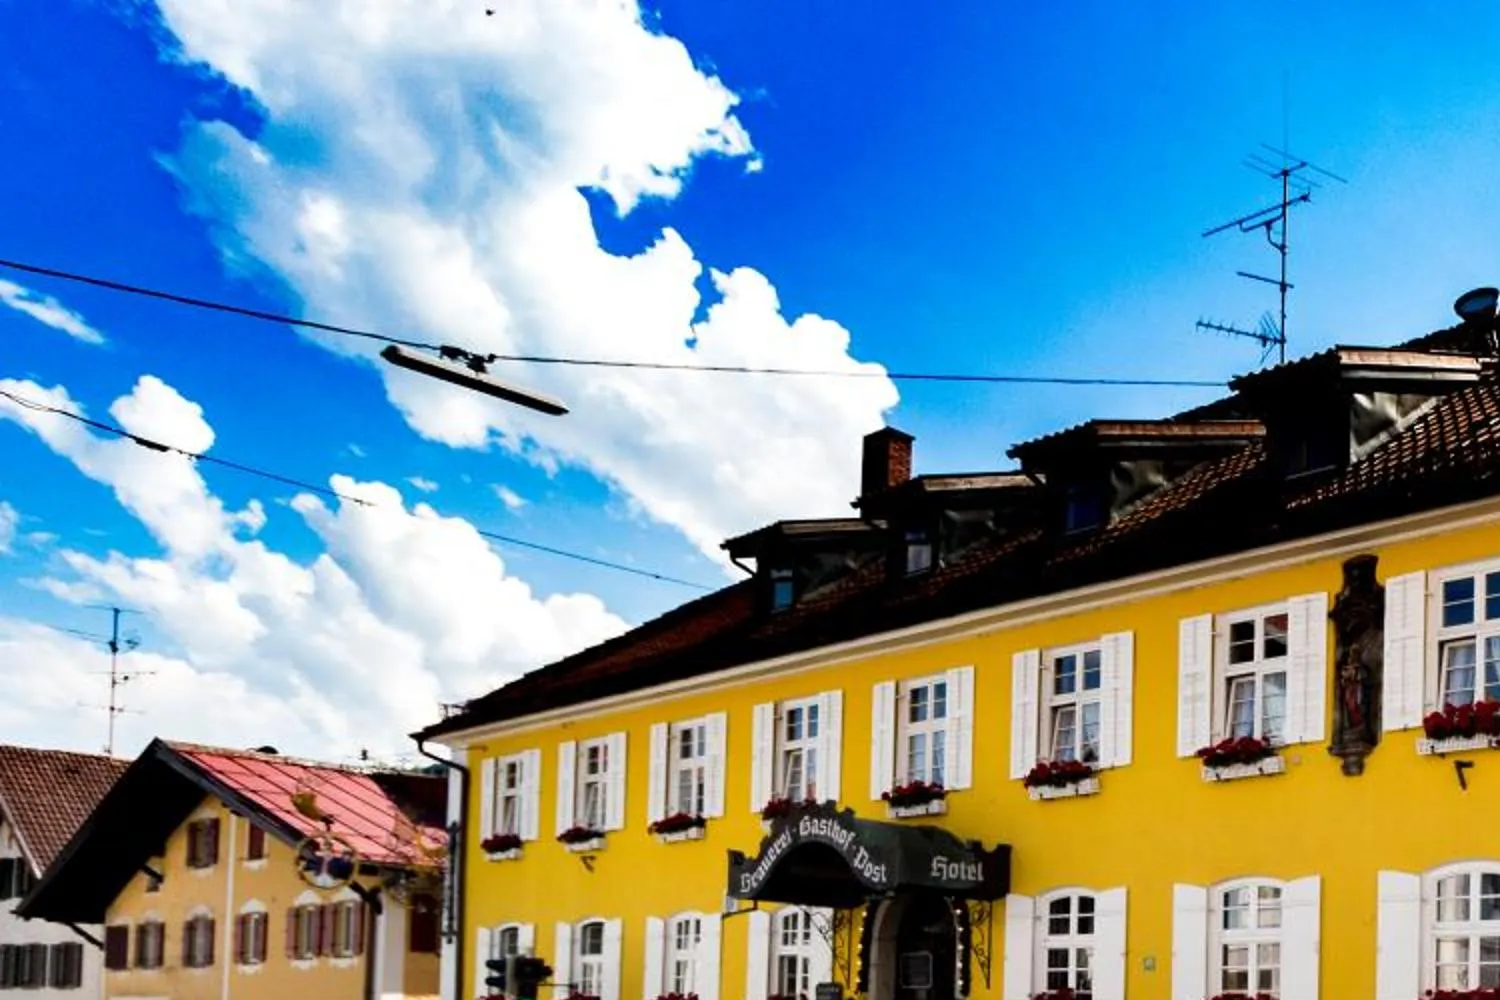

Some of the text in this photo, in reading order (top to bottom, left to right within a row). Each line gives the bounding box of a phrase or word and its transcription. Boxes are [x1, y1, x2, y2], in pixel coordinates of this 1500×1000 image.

[740, 814, 888, 894] Brauerei Gasthof Post
[930, 854, 985, 882] Hotel
